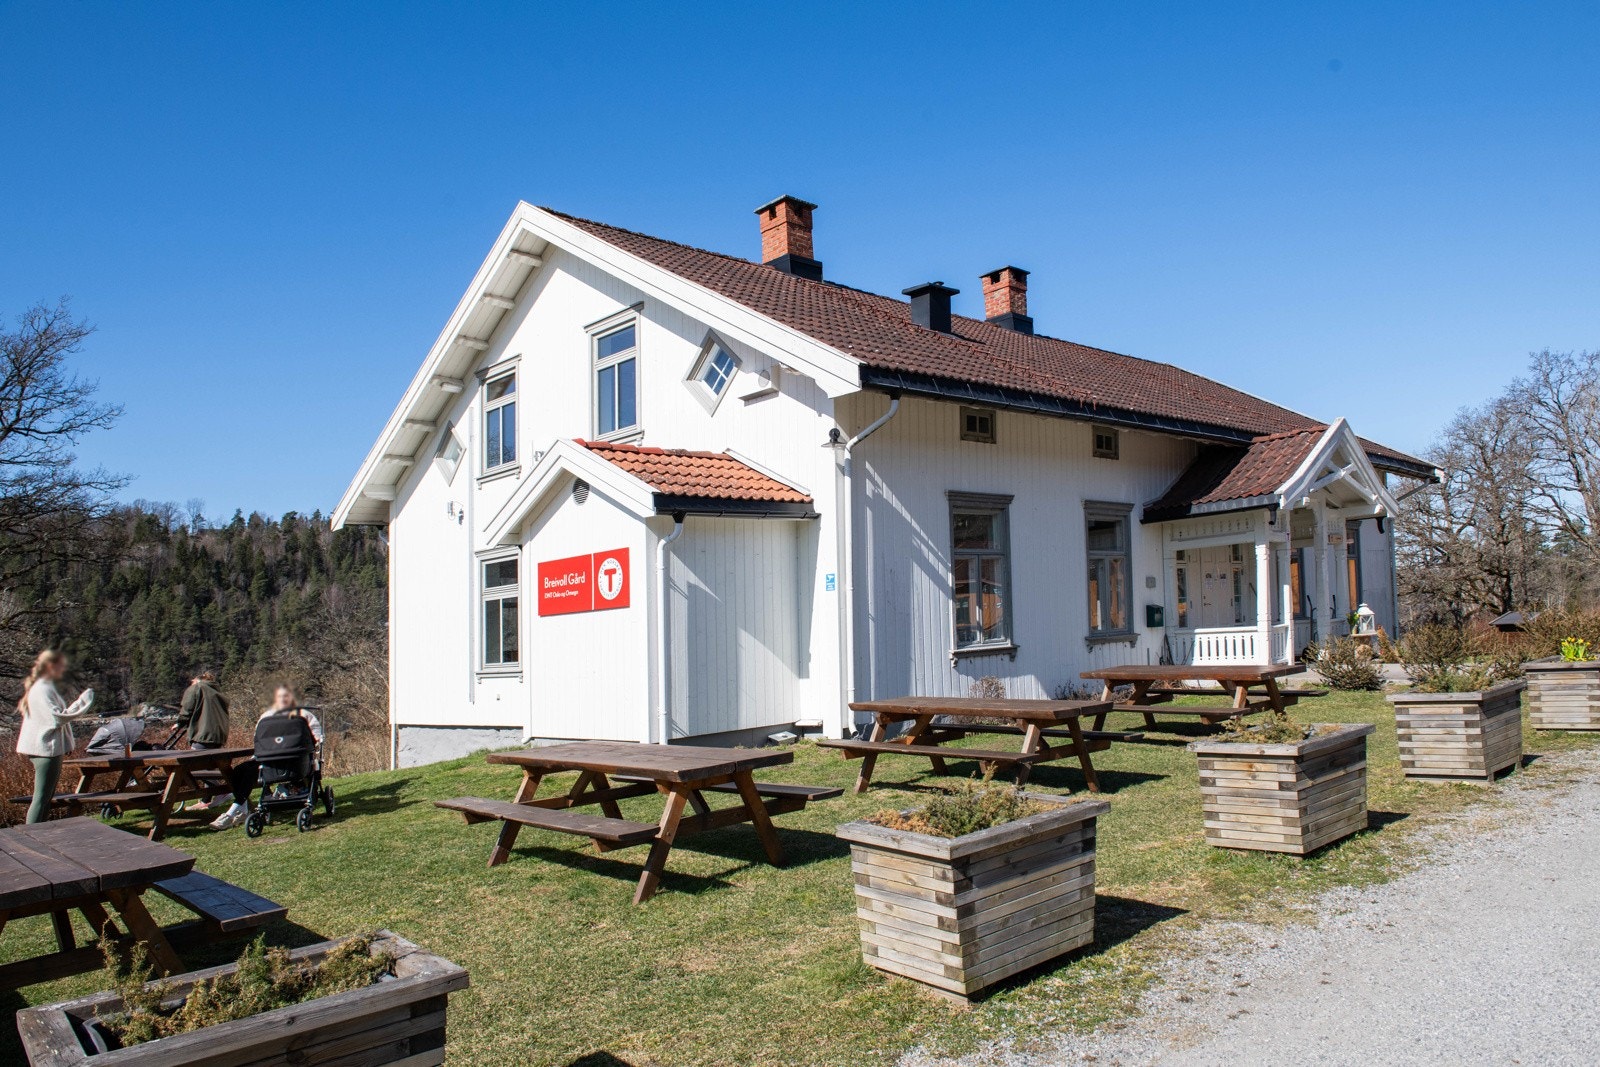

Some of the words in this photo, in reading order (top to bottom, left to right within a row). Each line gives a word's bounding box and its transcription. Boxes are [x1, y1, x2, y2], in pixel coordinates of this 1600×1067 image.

[544, 574, 567, 589] Breivoll
[568, 571, 586, 585] Gård
[604, 568, 617, 592] T
